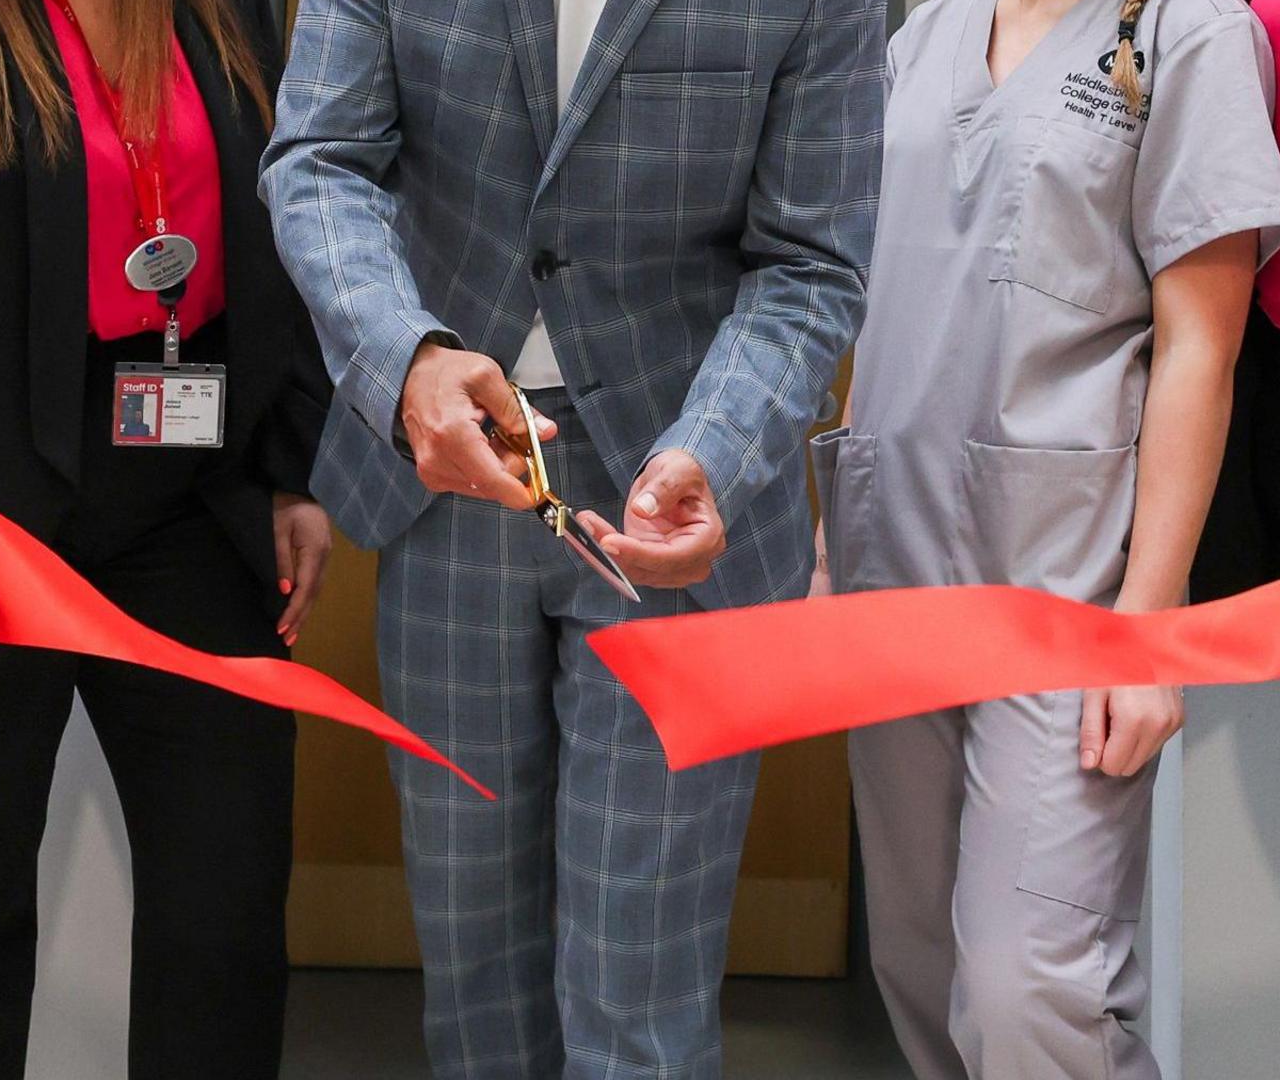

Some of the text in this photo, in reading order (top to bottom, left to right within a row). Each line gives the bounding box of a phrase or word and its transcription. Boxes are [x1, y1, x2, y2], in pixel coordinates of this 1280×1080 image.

[1061, 86, 1110, 109] College
[1065, 101, 1136, 132] Health T Level
[123, 383, 157, 393] Staff ID
